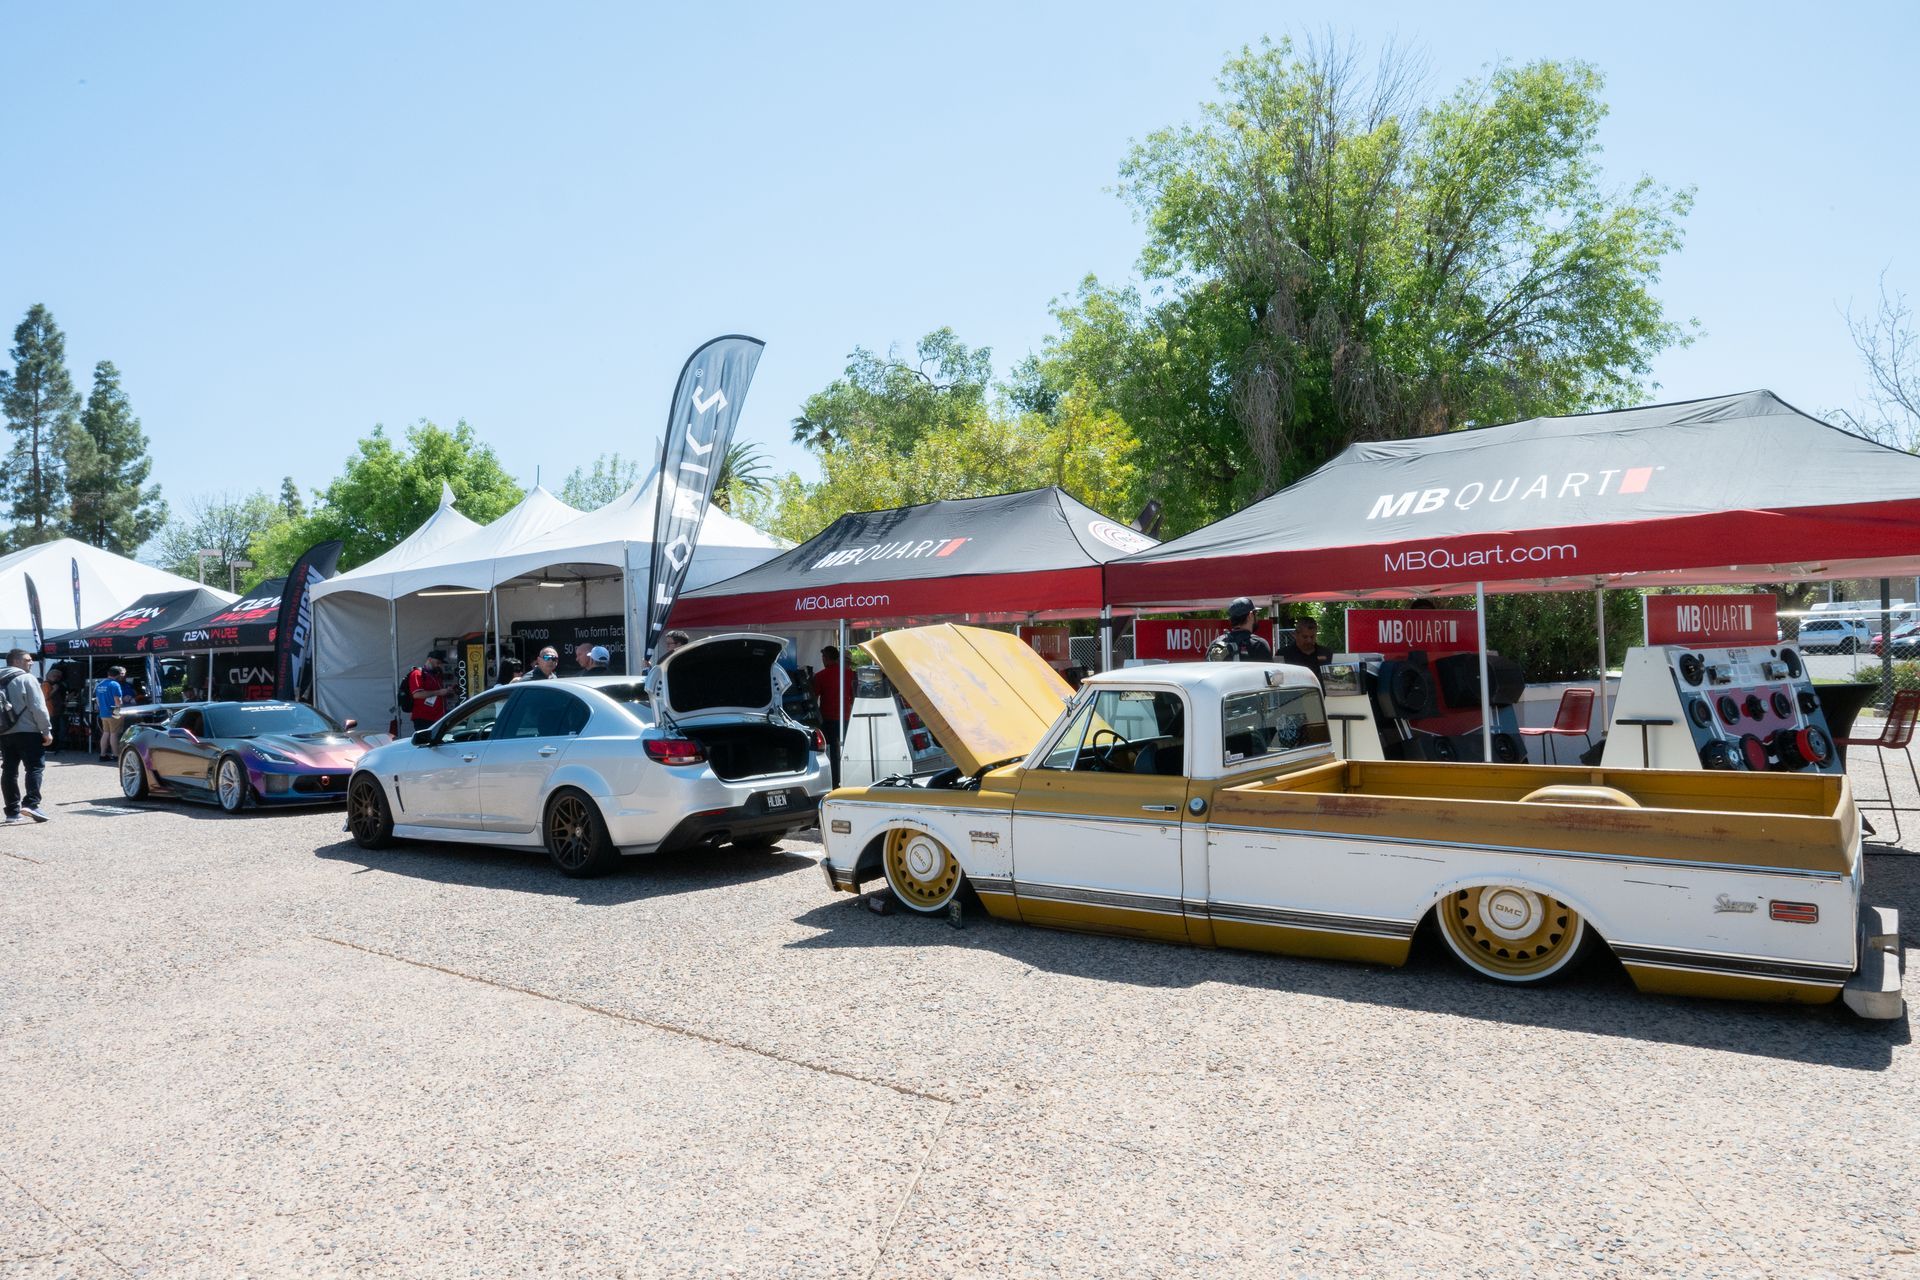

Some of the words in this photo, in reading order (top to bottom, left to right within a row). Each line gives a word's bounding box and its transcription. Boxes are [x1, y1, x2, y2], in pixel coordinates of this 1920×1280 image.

[1367, 469, 1621, 520] MBQUART
[811, 538, 944, 569] MBQUART
[1384, 543, 1577, 572] MBQuart.com
[795, 593, 890, 611] MBQuart.com
[1677, 604, 1744, 636] MBQUART
[574, 627, 589, 638] Two
[590, 626, 609, 638] form
[1378, 620, 1449, 646] MBQUART
[564, 643, 574, 655] 50
[767, 794, 788, 807] HLDEN
[1495, 903, 1522, 917] GMC
